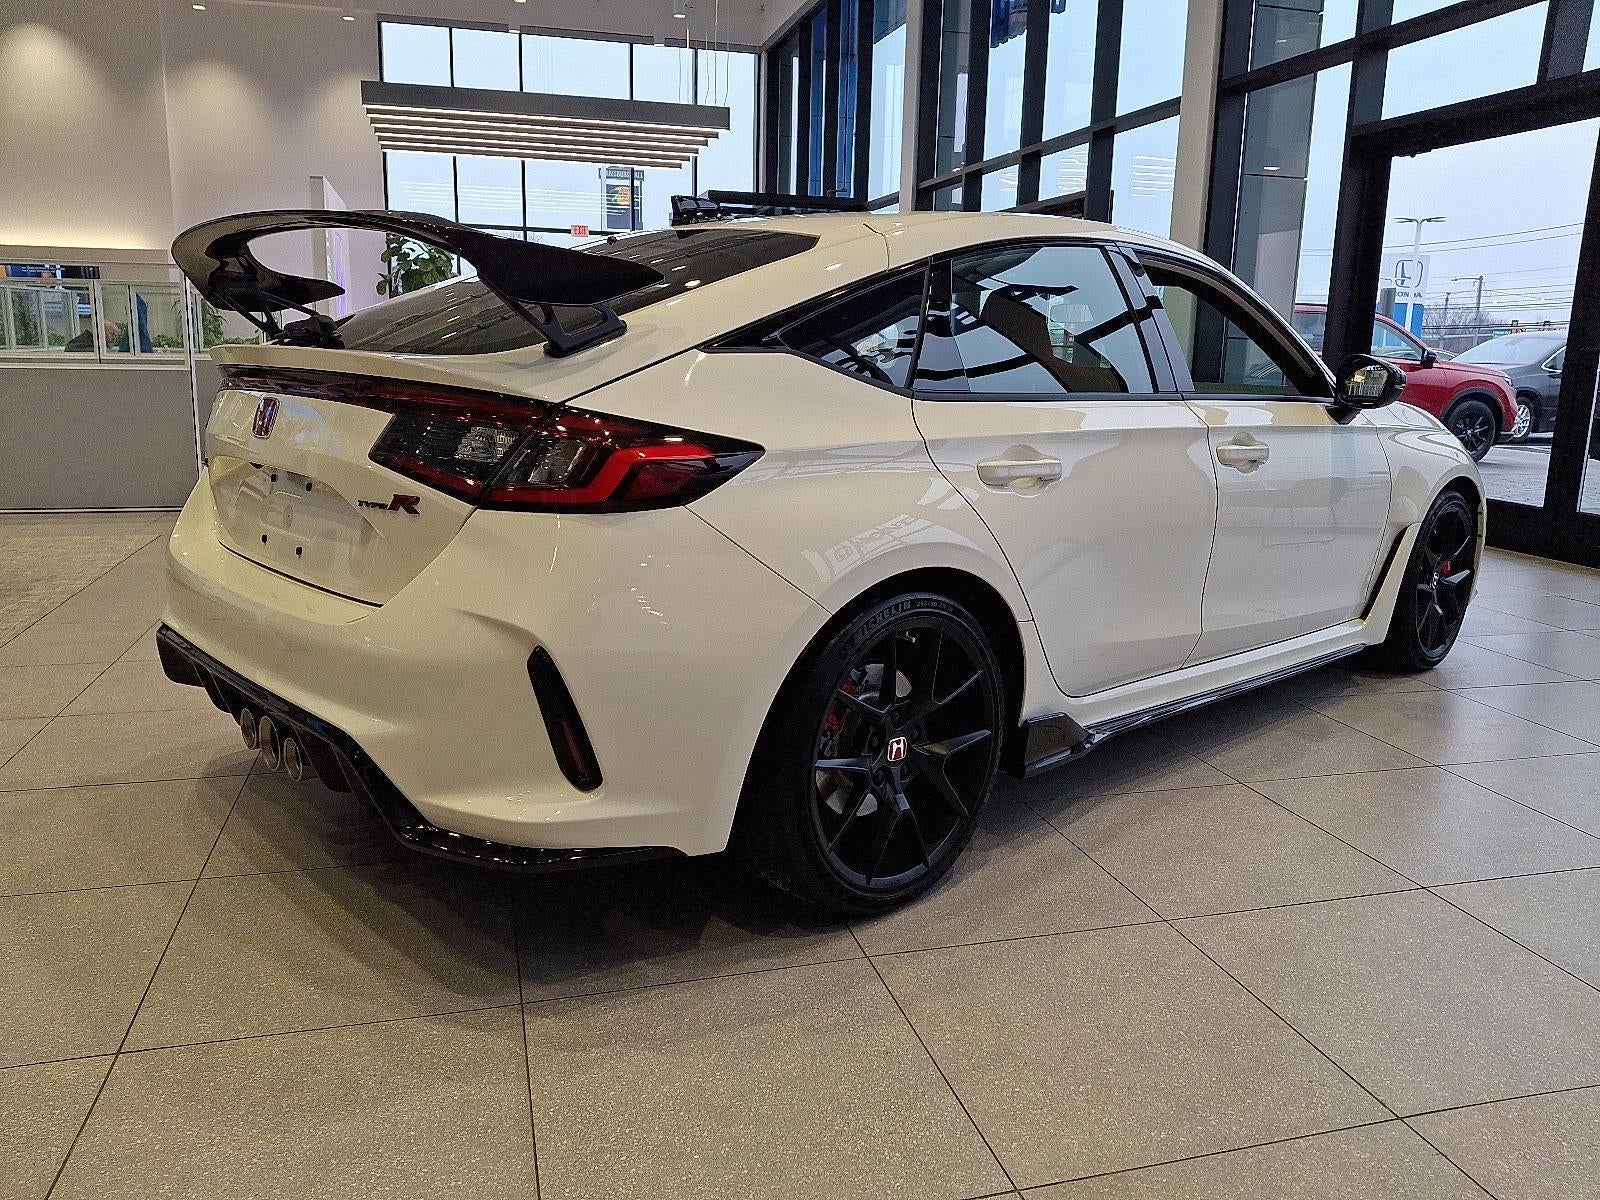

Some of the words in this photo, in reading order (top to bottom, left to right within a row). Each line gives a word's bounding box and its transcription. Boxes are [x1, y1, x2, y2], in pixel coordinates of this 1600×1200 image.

[574, 225, 587, 235] EXIT
[357, 499, 388, 511] TYPE
[387, 493, 421, 515] R
